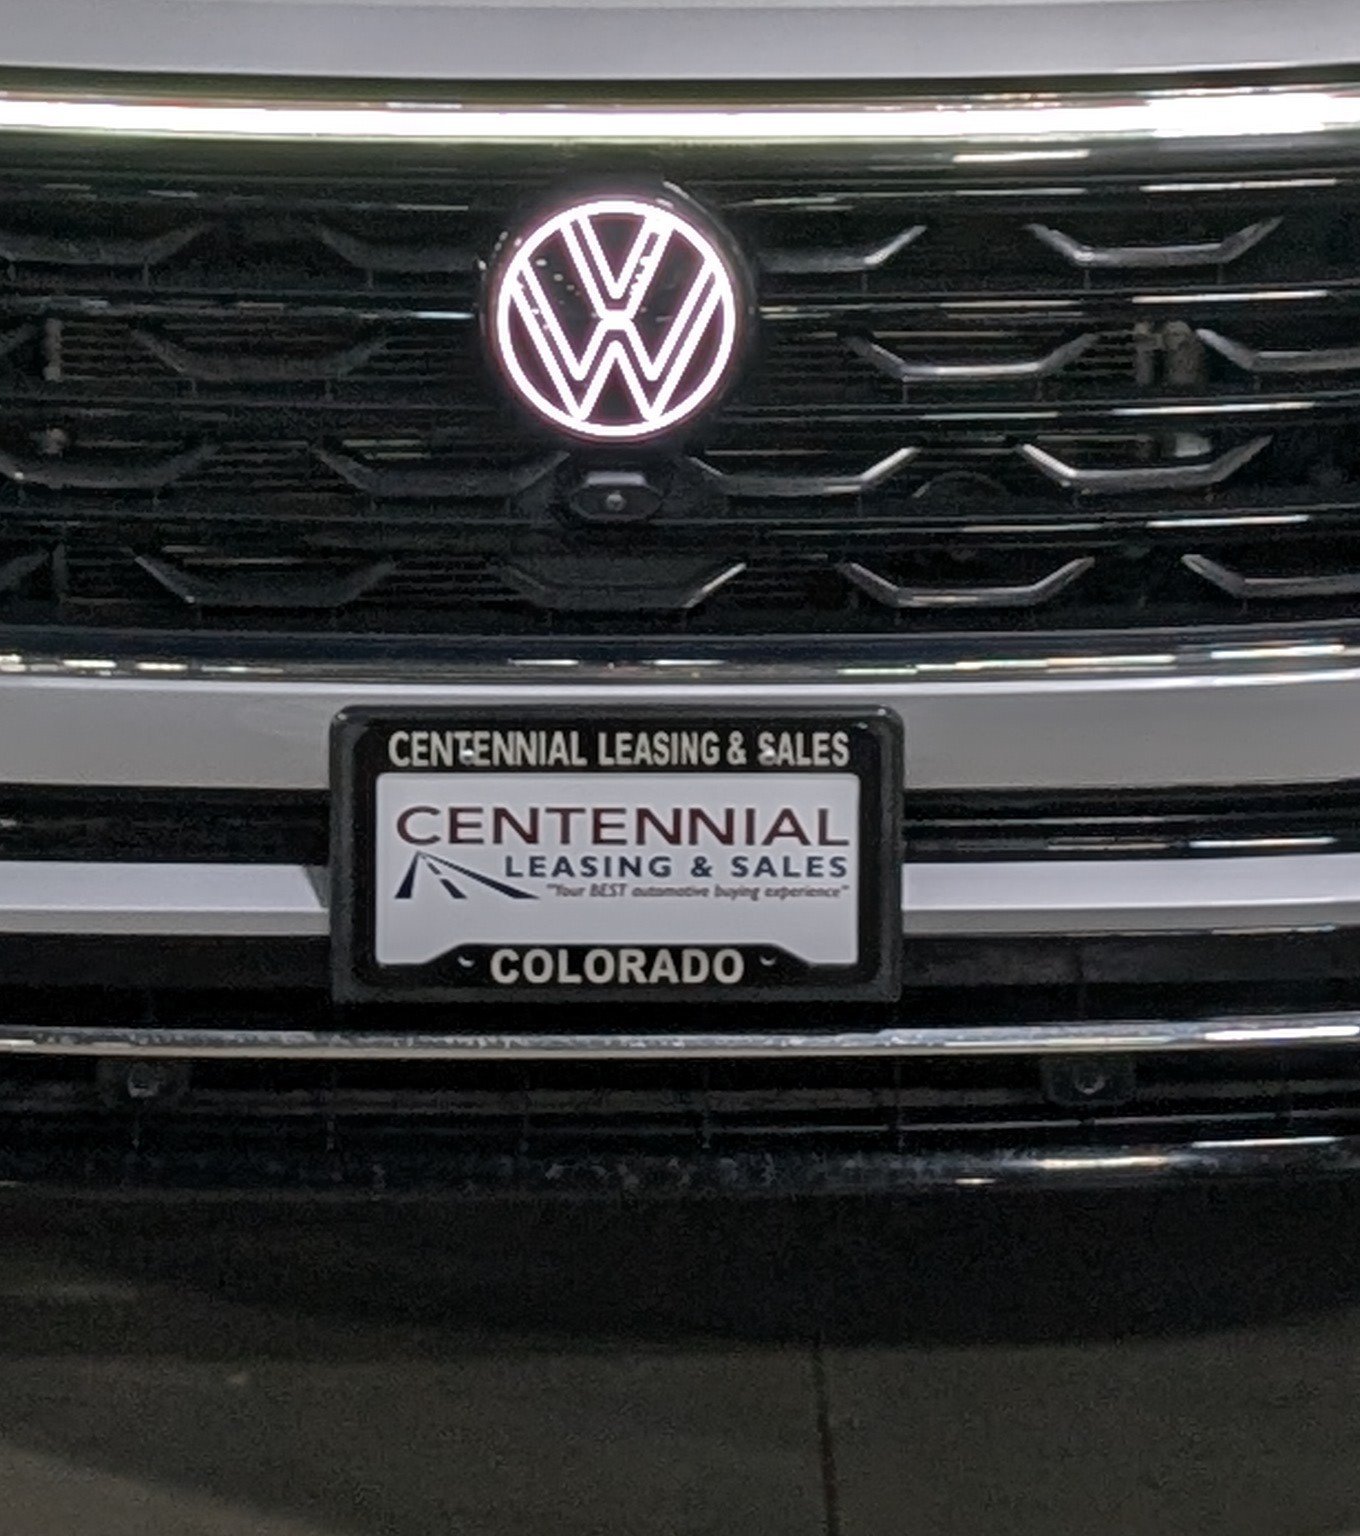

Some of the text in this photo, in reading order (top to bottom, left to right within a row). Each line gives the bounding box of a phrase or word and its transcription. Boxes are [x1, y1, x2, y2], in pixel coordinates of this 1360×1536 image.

[388, 731, 851, 767] CENTENNIAL LEASING & SALES
[396, 806, 851, 846] CENTENNIAL
[505, 855, 848, 879] LEASING & SALES
[589, 883, 628, 898] BEST
[631, 884, 709, 898] automotive
[714, 883, 760, 901] buying
[490, 948, 745, 985] COLORADO
